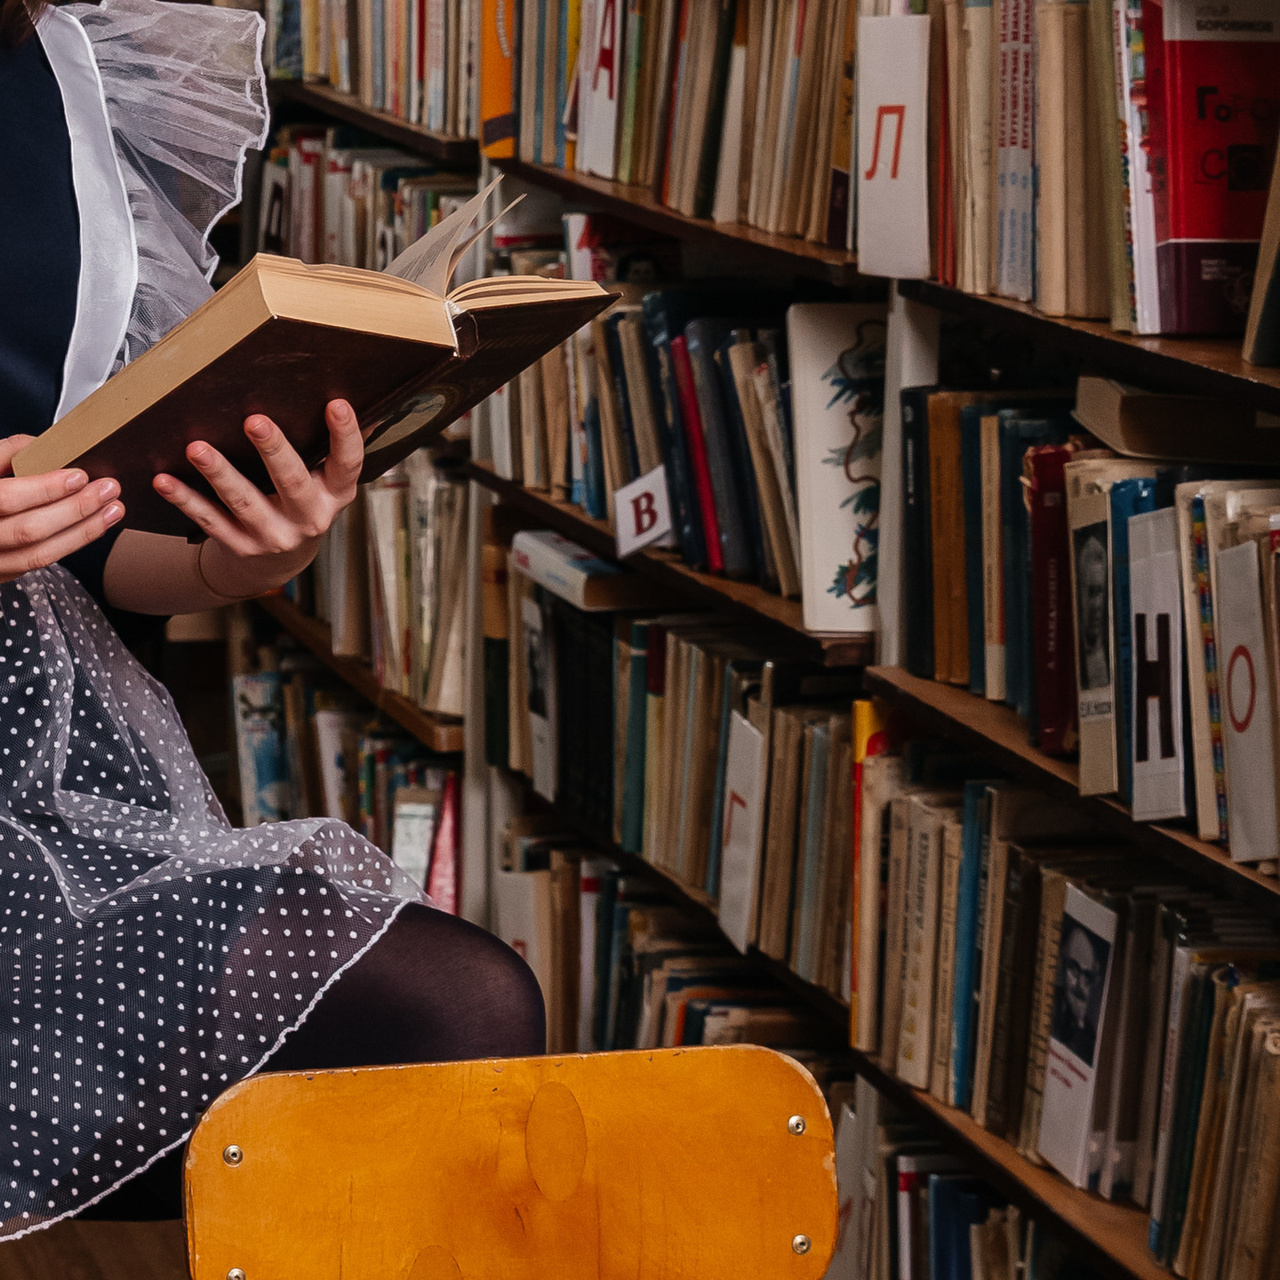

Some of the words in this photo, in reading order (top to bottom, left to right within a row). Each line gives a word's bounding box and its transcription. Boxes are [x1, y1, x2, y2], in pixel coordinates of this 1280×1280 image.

[865, 105, 907, 181] Л
[630, 490, 659, 536] В
[1135, 612, 1177, 763] Н
[1227, 645, 1256, 734] О
